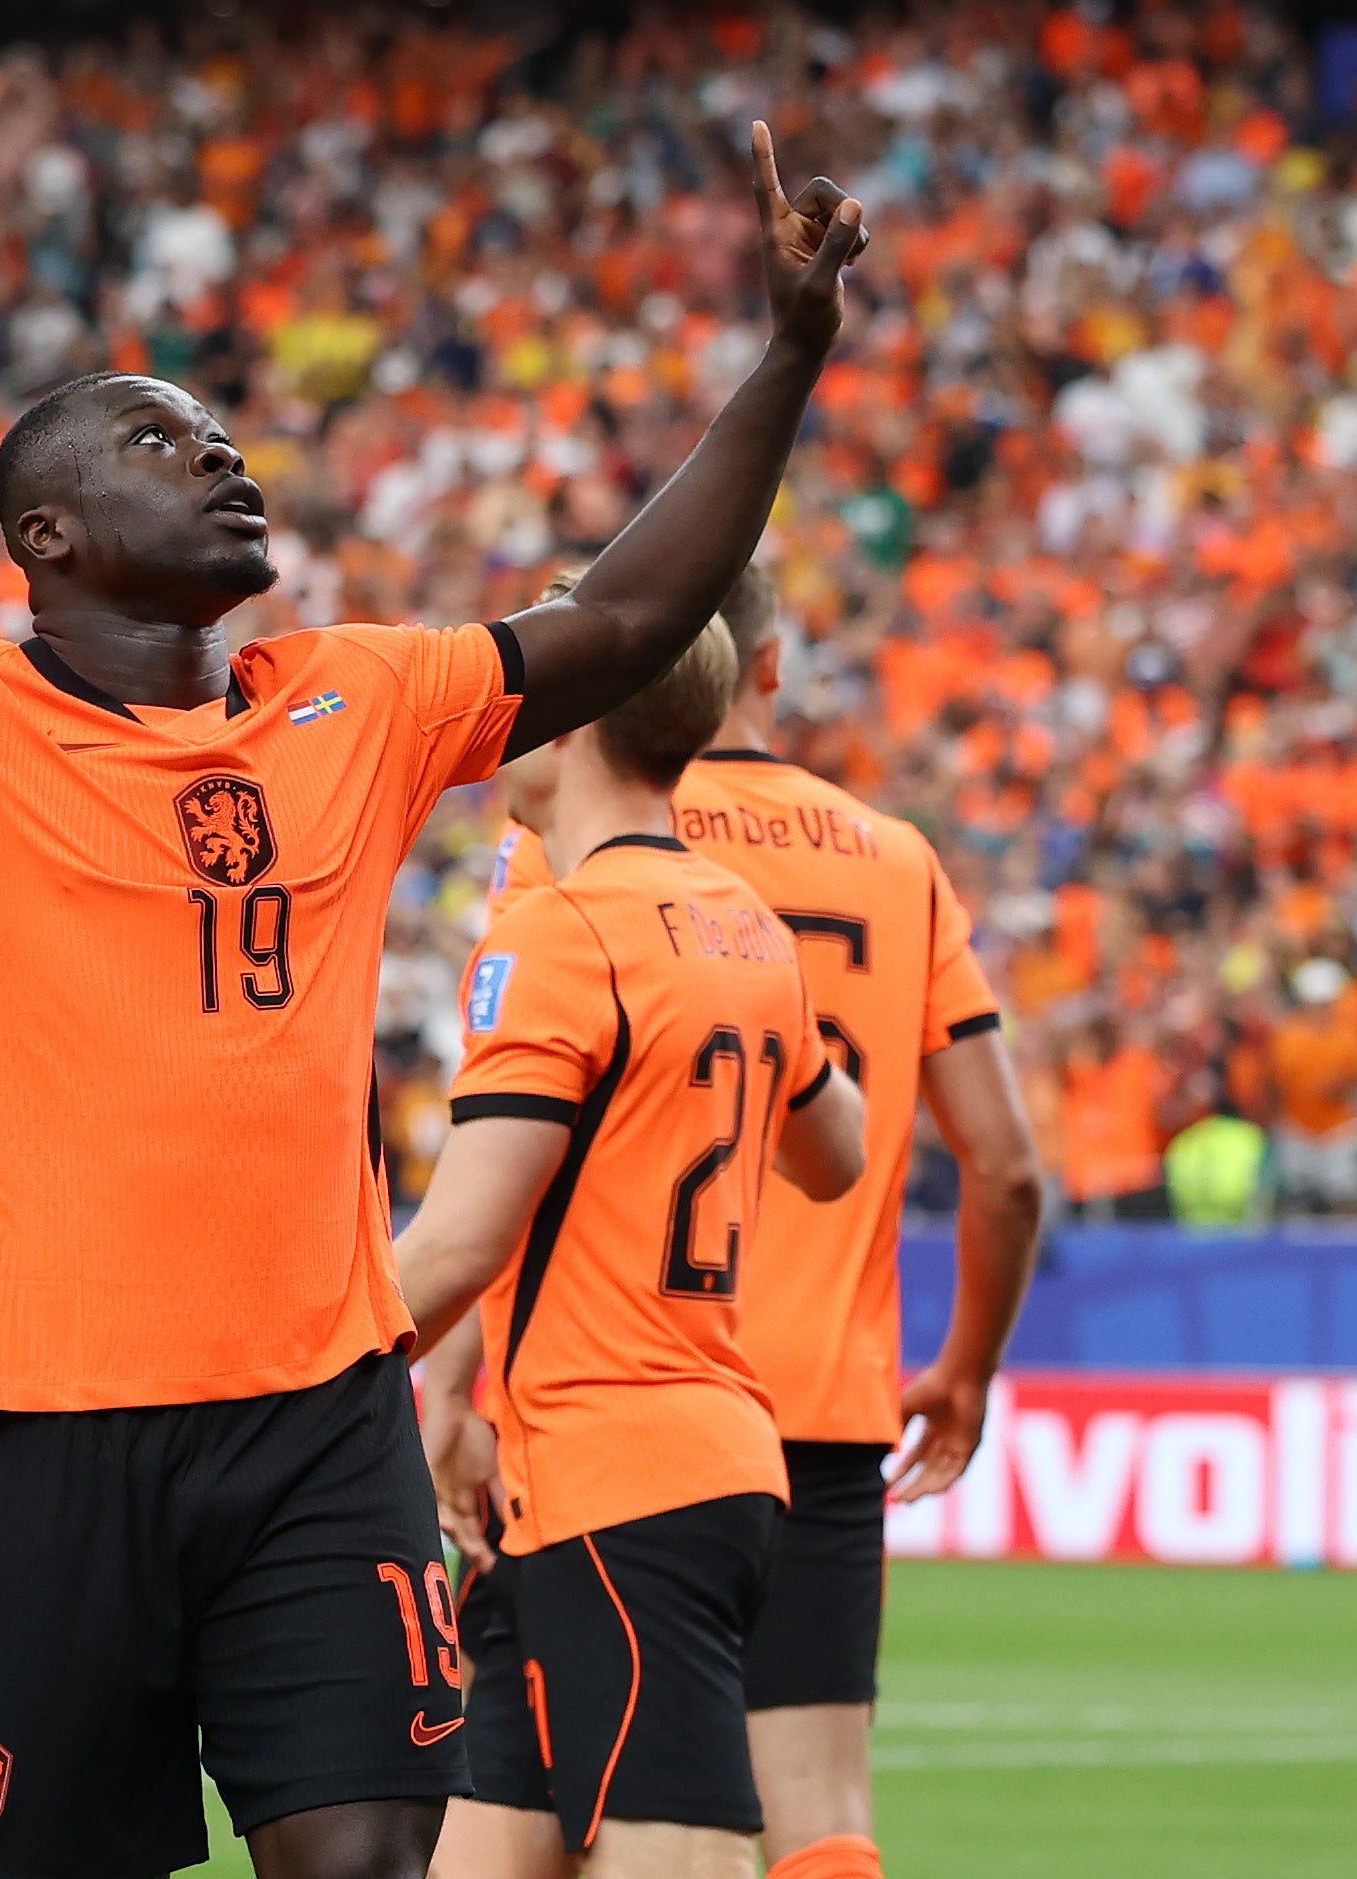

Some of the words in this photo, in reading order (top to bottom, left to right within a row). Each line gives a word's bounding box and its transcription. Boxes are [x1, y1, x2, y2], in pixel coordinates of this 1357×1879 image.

[673, 807, 733, 843] an
[738, 805, 791, 848] De
[188, 884, 294, 1013] 19
[658, 1025, 788, 1300] 21
[377, 1561, 462, 1689] 19
